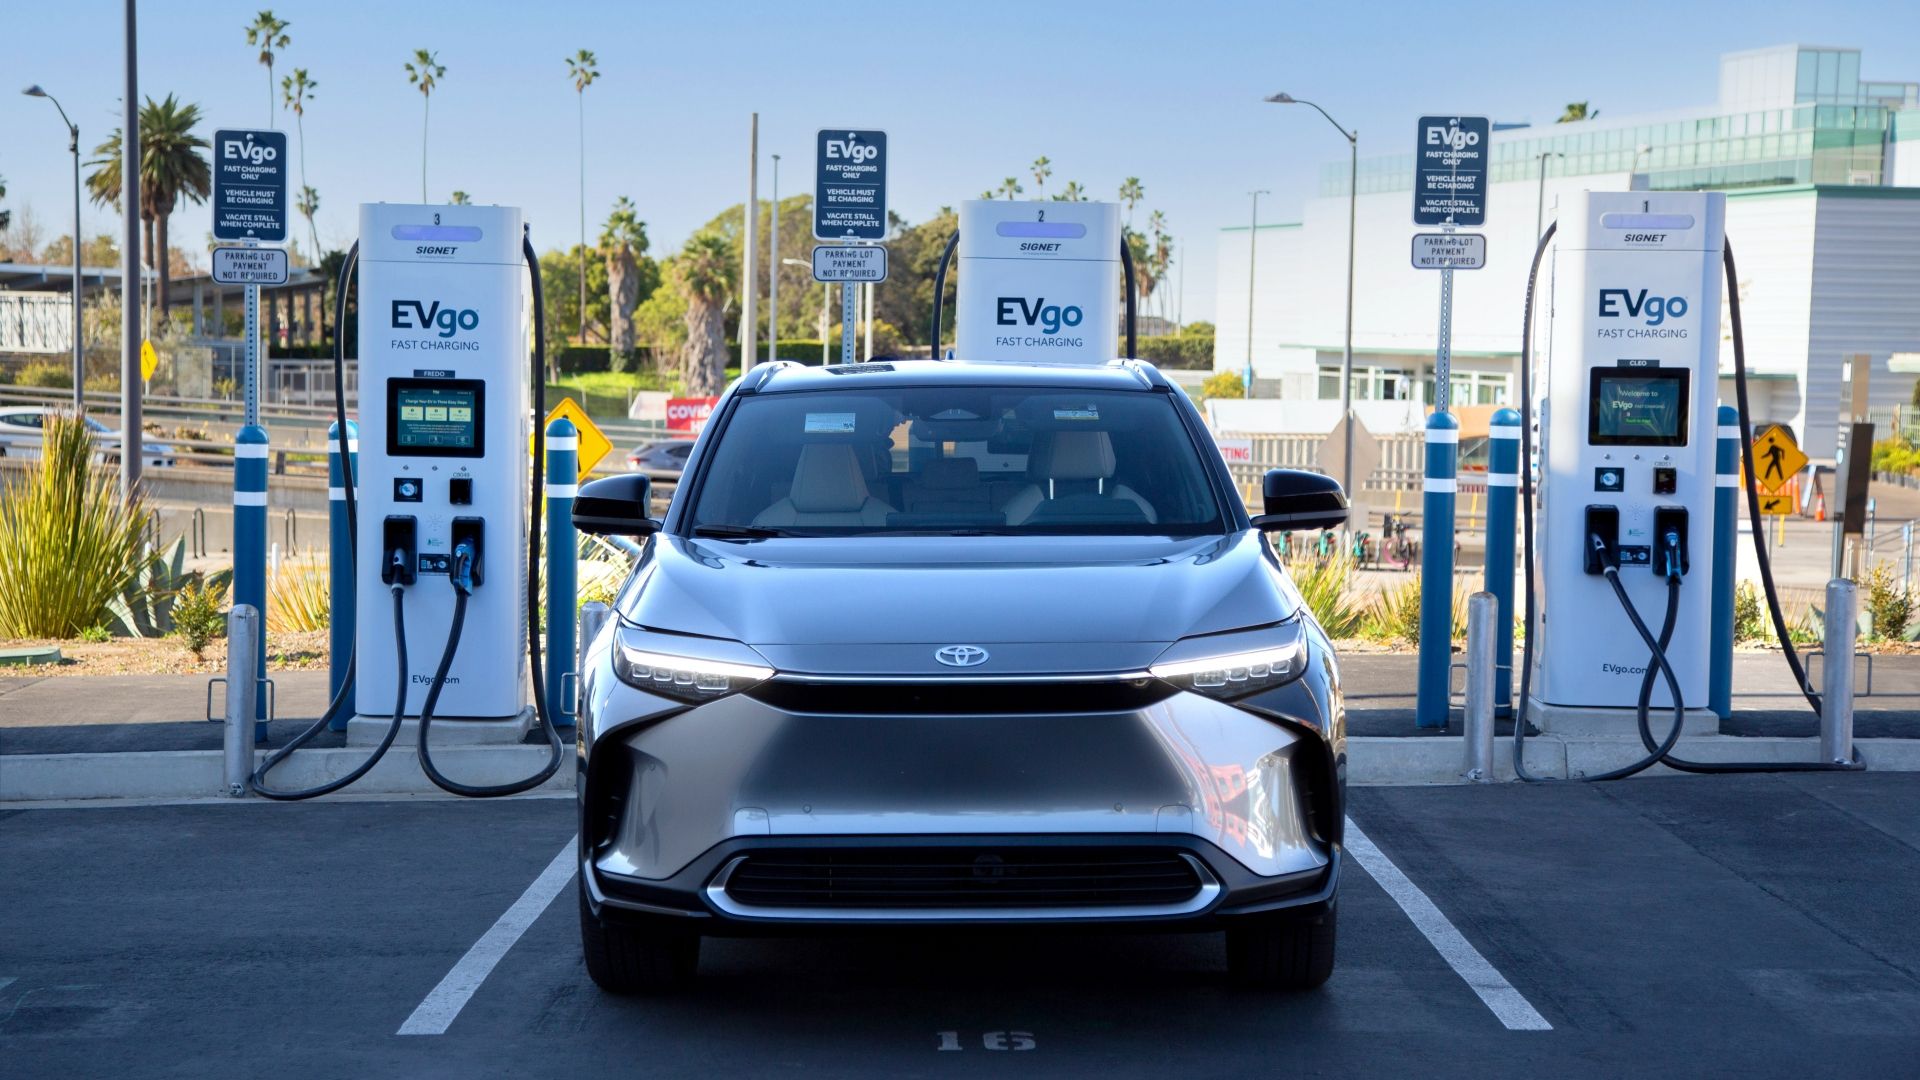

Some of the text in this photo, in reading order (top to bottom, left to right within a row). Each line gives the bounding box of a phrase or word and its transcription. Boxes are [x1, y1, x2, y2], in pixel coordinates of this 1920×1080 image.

[1426, 126, 1479, 150] EVgo
[224, 140, 277, 165] EVgo
[826, 140, 878, 164] EVgo
[1443, 151, 1479, 159] CHARGING
[224, 165, 277, 174] FAST CHARGING
[1456, 175, 1477, 183] MUST
[1437, 182, 1475, 190] CHARGING
[225, 189, 275, 198] VEHICLE MUST
[826, 188, 856, 196] VEHICLE
[237, 197, 274, 205] CHARGING
[1453, 199, 1475, 207] STALL
[1643, 200, 1649, 213] 1
[225, 213, 275, 222] VACATE STALL
[434, 212, 441, 226] 3
[826, 212, 853, 220] VACATE
[1038, 209, 1045, 223] 2
[242, 221, 280, 230] COMPLETE
[1459, 238, 1474, 246] LOT
[1624, 233, 1668, 243] SIGNET
[415, 246, 458, 255] SIGNET
[1019, 242, 1062, 252] SIGNET
[1431, 247, 1466, 256] PAYMENT
[260, 253, 275, 261] LOT
[860, 250, 874, 259] LOT
[832, 260, 866, 268] PAYMENT
[1420, 257, 1435, 265] NOT
[233, 262, 268, 270] PAYMENT
[222, 271, 238, 279] NOT
[822, 269, 837, 278] NOT
[1598, 288, 1688, 326] EVgo
[391, 300, 480, 338] EVgo
[997, 296, 1083, 335] EVgo
[1597, 328, 1688, 339] FAST CHARGING
[391, 340, 480, 351] FAST CHARGING
[996, 336, 1083, 347] FAST CHARGING
[1620, 389, 1650, 397] Welcome
[1612, 400, 1633, 410] EVgo
